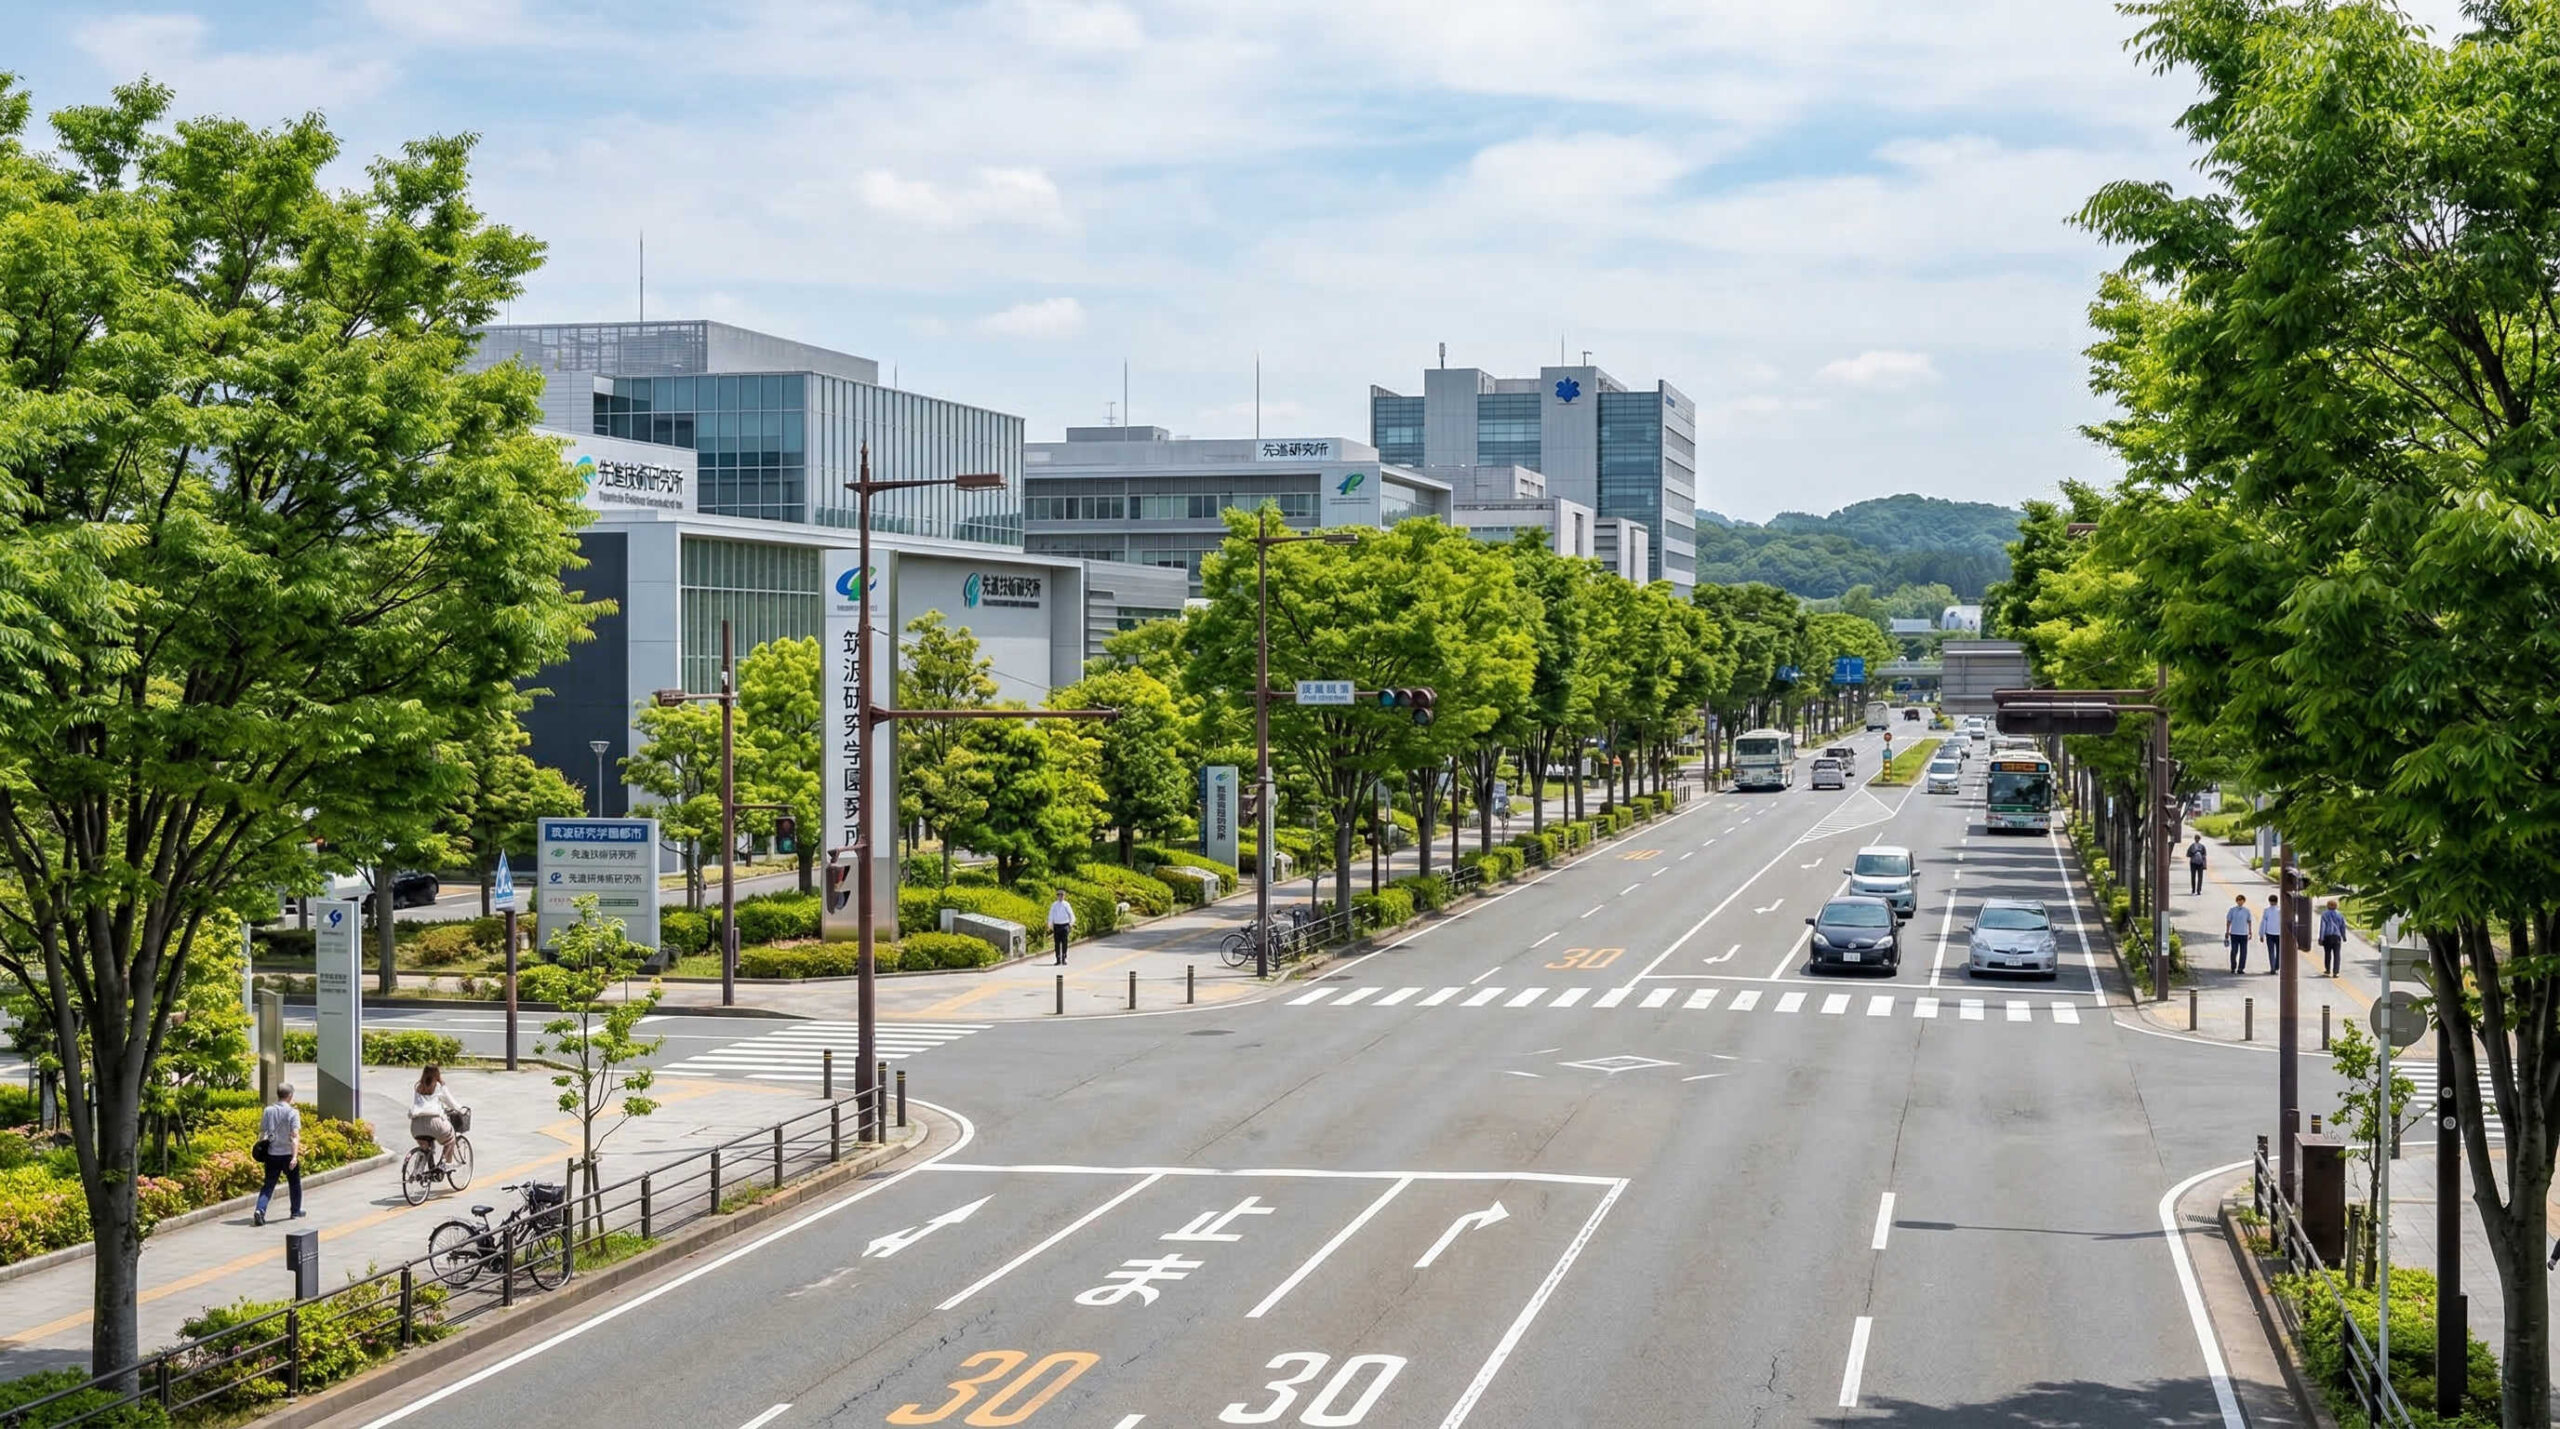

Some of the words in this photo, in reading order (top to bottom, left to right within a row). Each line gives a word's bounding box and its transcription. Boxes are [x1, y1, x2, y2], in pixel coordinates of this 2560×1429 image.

[1545, 949, 1625, 968] 30
[886, 1350, 1101, 1426] 30
[1218, 1351, 1408, 1427] 30
